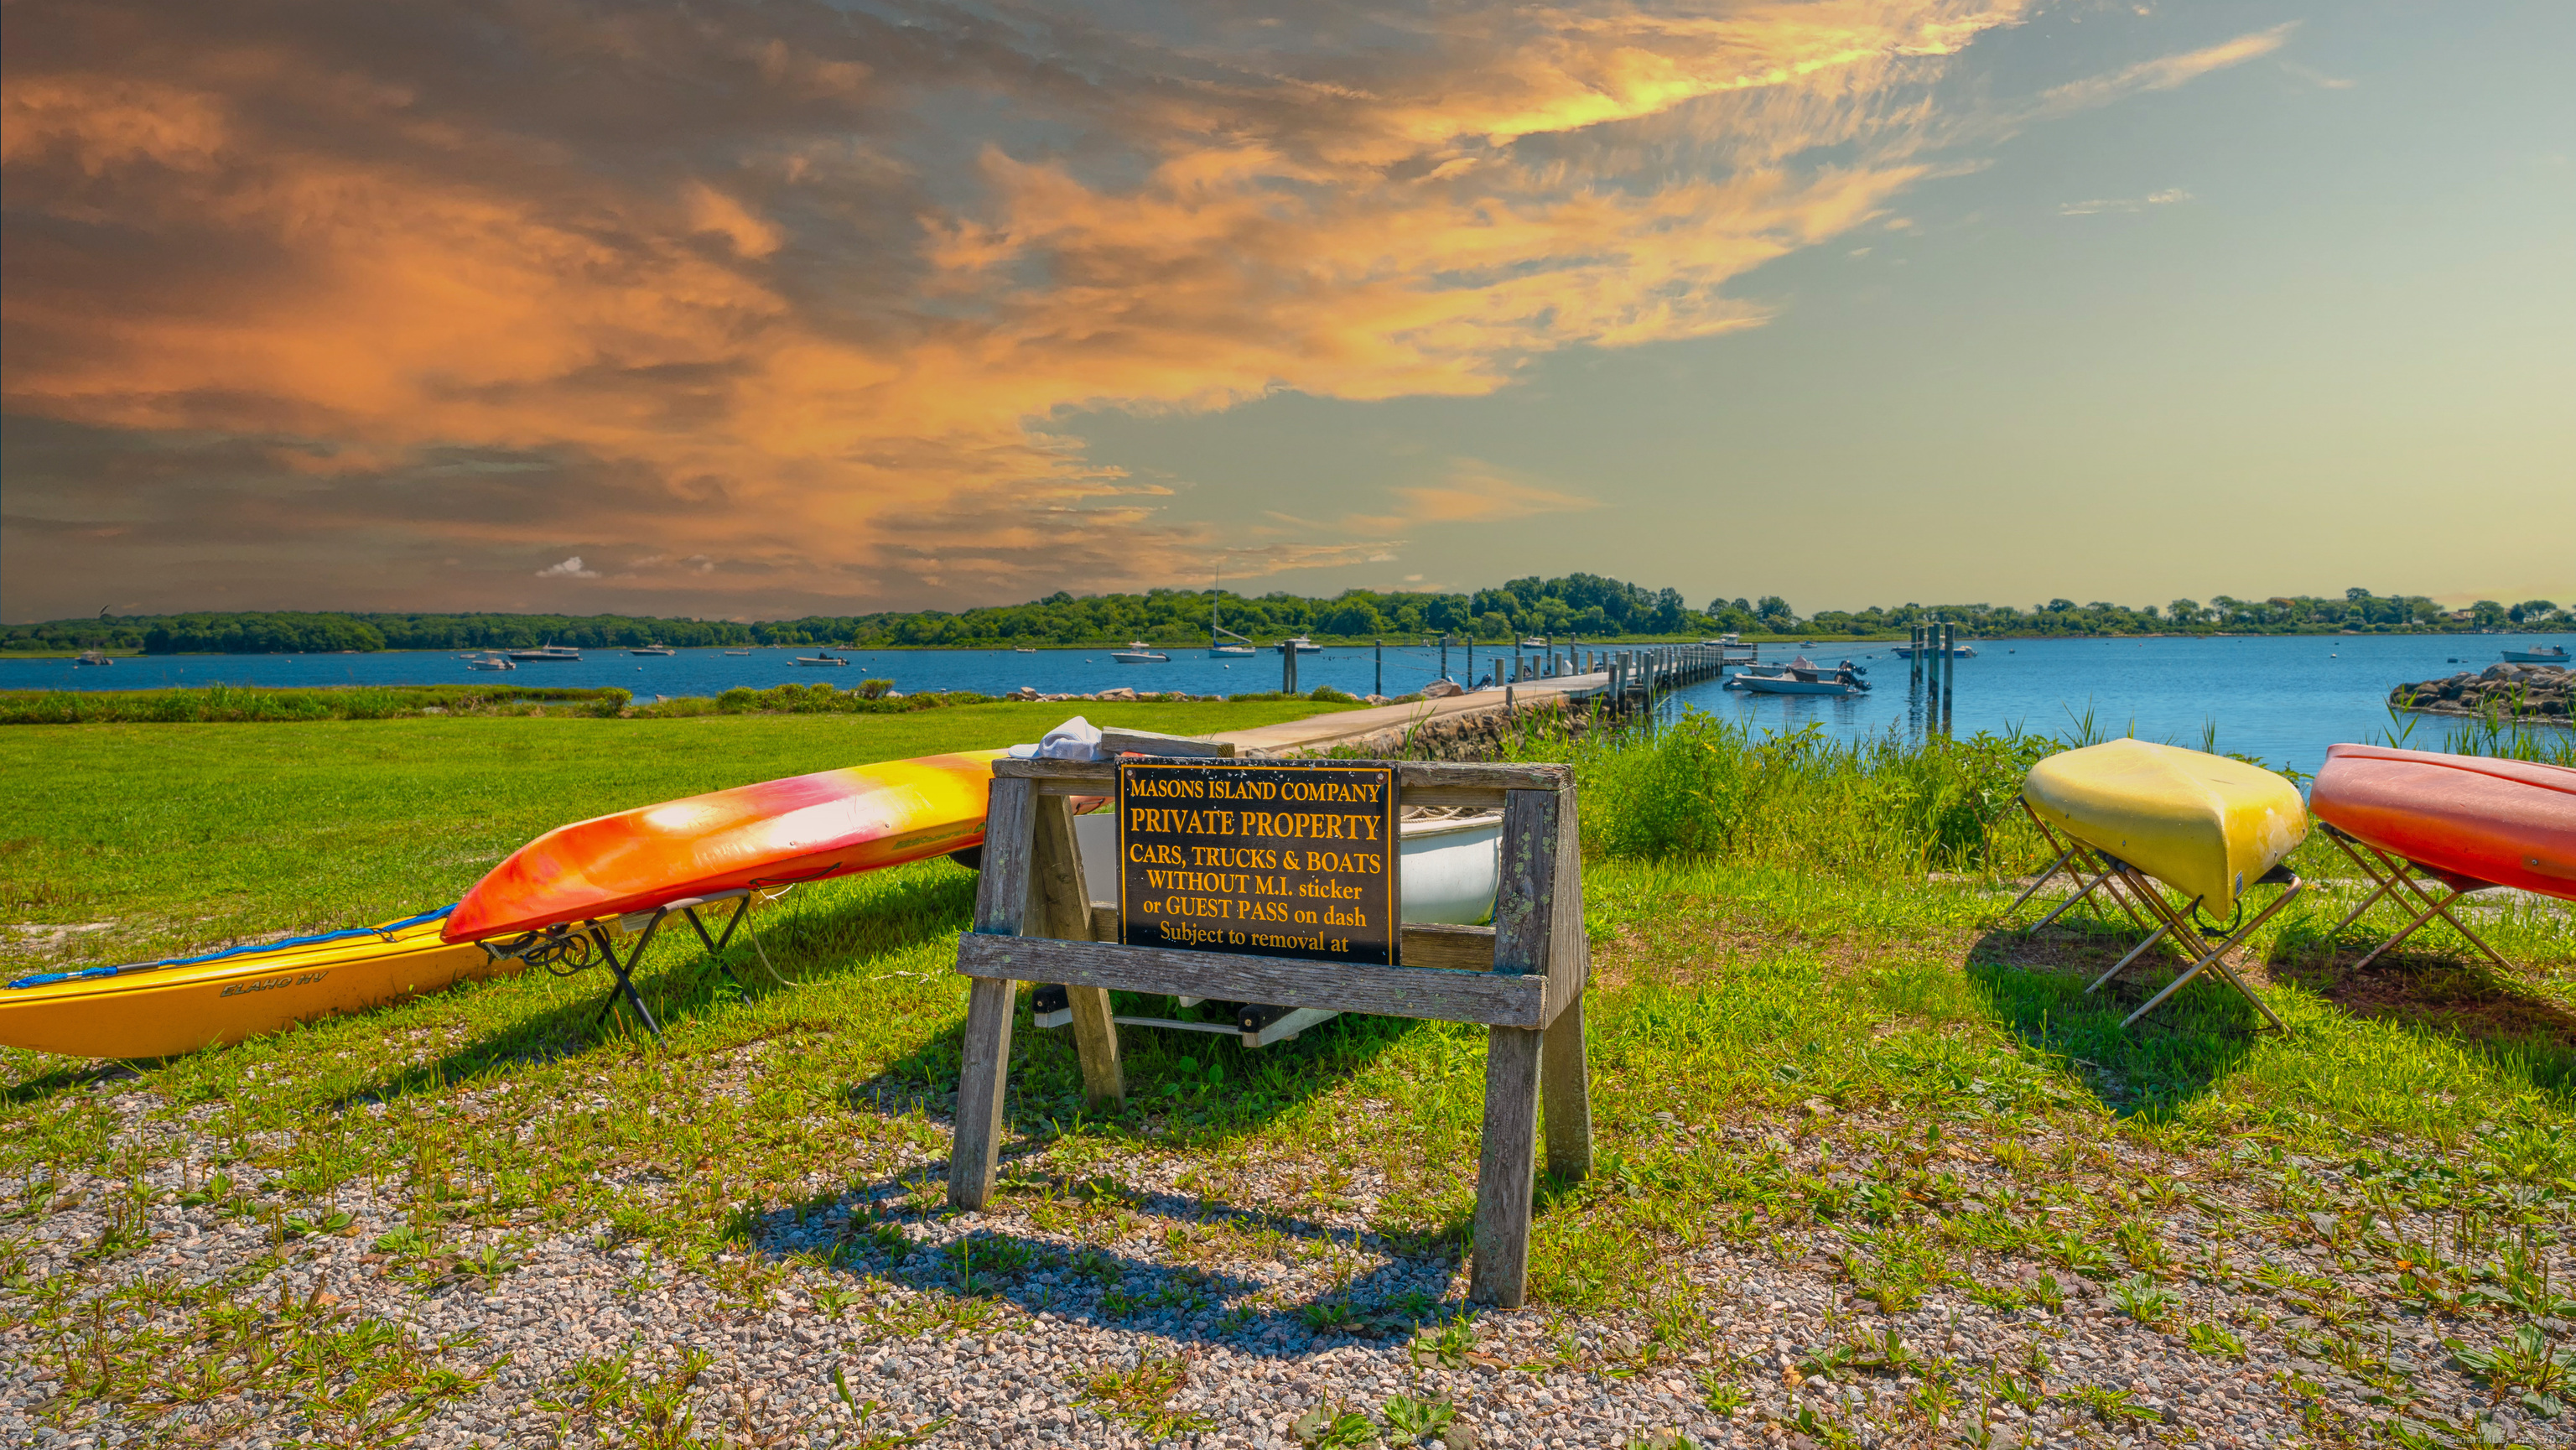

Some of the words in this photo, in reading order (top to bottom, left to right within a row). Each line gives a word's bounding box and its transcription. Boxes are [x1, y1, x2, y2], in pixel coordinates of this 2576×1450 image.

[1130, 779, 1204, 799] MASONS
[1208, 781, 1277, 801] ISLAND
[1280, 782, 1381, 803] COMPANY
[1130, 808, 1235, 836] PRIVATE
[1239, 811, 1381, 841] PROPERTY
[1129, 843, 1187, 870] CARS,
[1191, 846, 1277, 871] TRUCKS
[1282, 850, 1301, 871] &
[1305, 850, 1381, 875] BOATS
[1146, 869, 1250, 895] WITHOUT
[1254, 875, 1294, 897] M.I.
[1298, 879, 1363, 901] sticker
[1142, 900, 1162, 915] or
[1166, 896, 1233, 920] GUEST
[1237, 900, 1289, 923] PASS
[1293, 909, 1319, 925] on
[1322, 904, 1368, 928] dash
[1160, 920, 1223, 946] Subject
[1228, 925, 1246, 945] to
[1251, 932, 1326, 953] removal
[1331, 936, 1350, 954] at
[220, 976, 293, 998] ELAHO
[296, 971, 329, 985] HV
